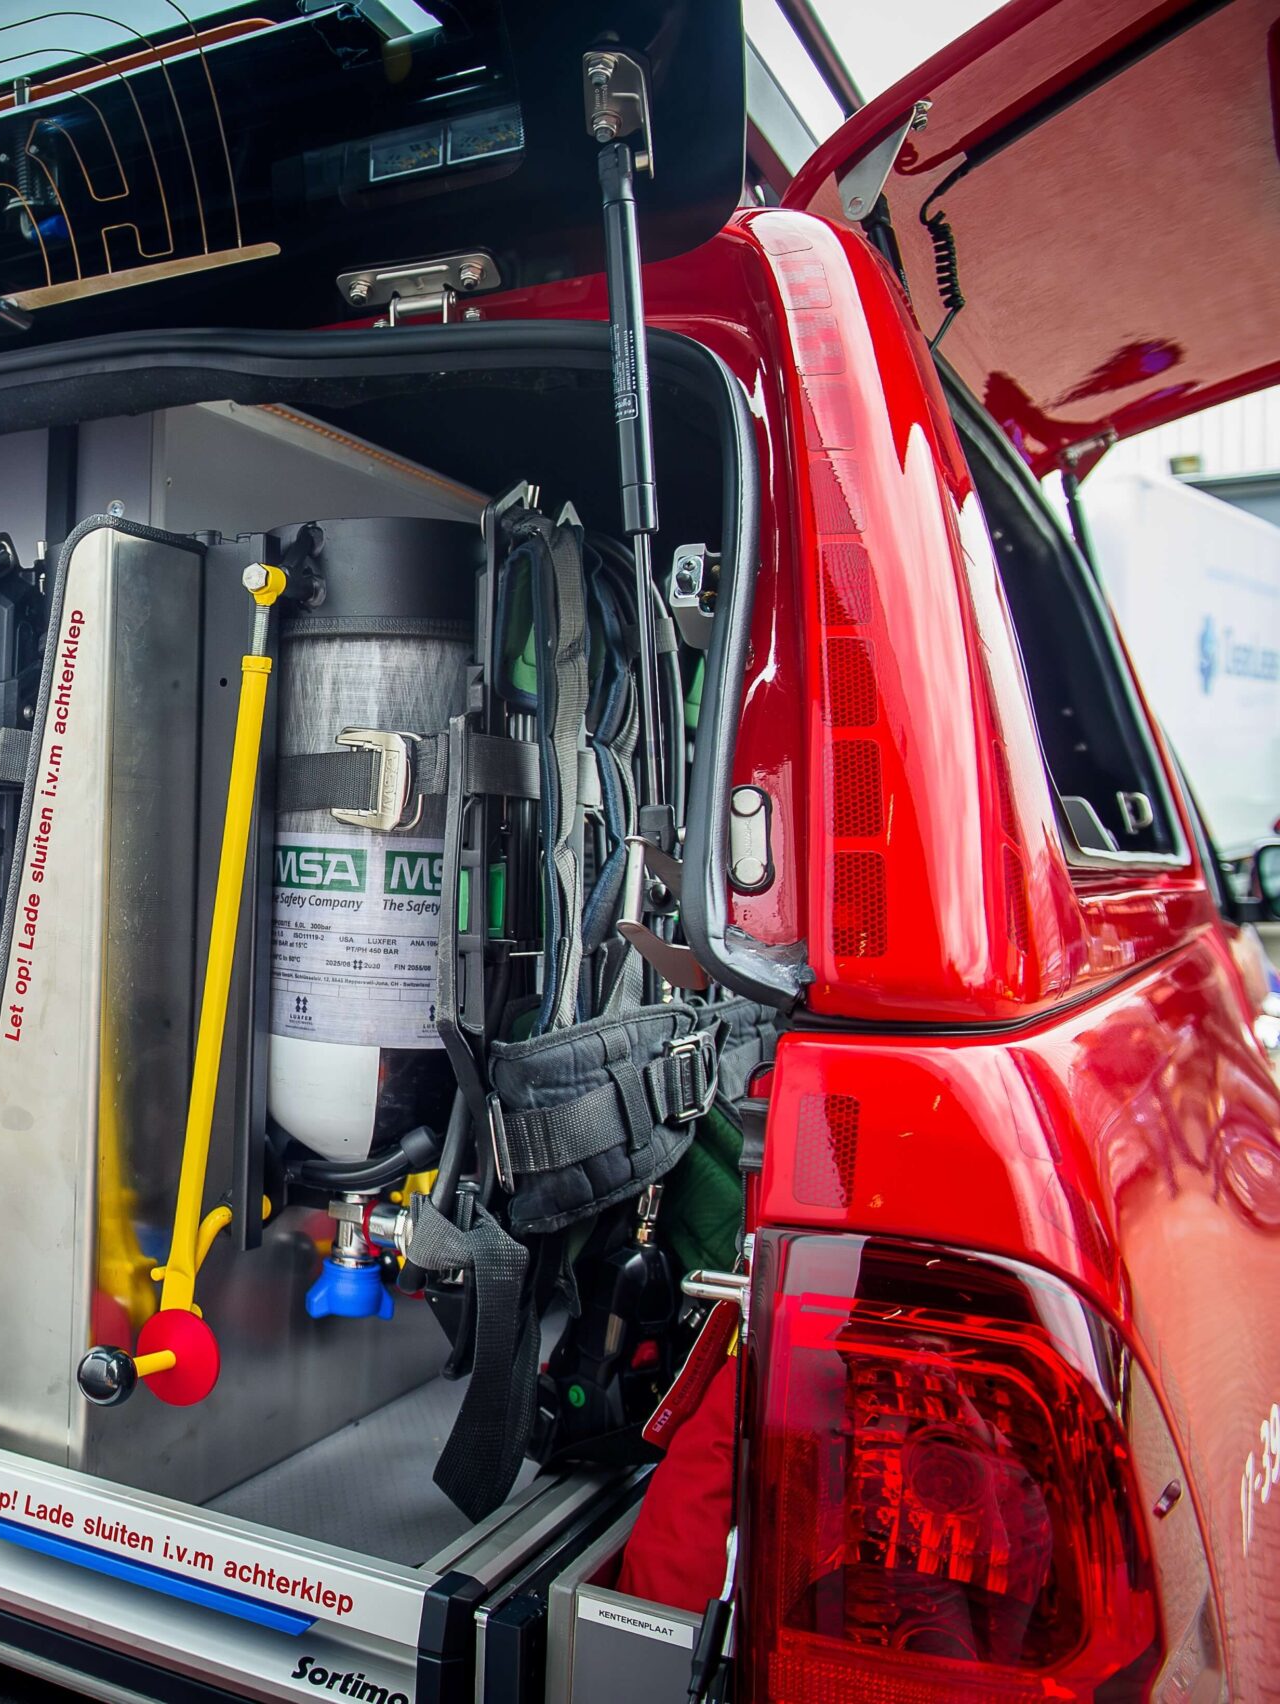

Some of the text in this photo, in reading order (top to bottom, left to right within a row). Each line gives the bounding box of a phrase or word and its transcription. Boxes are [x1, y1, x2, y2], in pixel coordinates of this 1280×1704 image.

[4, 610, 85, 1042] Let op! Lade sluiten i.v.m achterklep
[275, 851, 360, 887] MSA
[390, 856, 444, 890] MS
[280, 893, 306, 908] Safety
[308, 895, 363, 911] Company
[383, 899, 441, 916] The Safety
[368, 938, 397, 946] LUXFER
[24, 1495, 75, 1529] Lade
[83, 1516, 155, 1553] sluiten
[162, 1536, 214, 1571] i.v.m
[223, 1559, 354, 1615] achterklep
[599, 1609, 674, 1636] KENTEKENPLAAT
[291, 1656, 409, 1704] Sortimo
